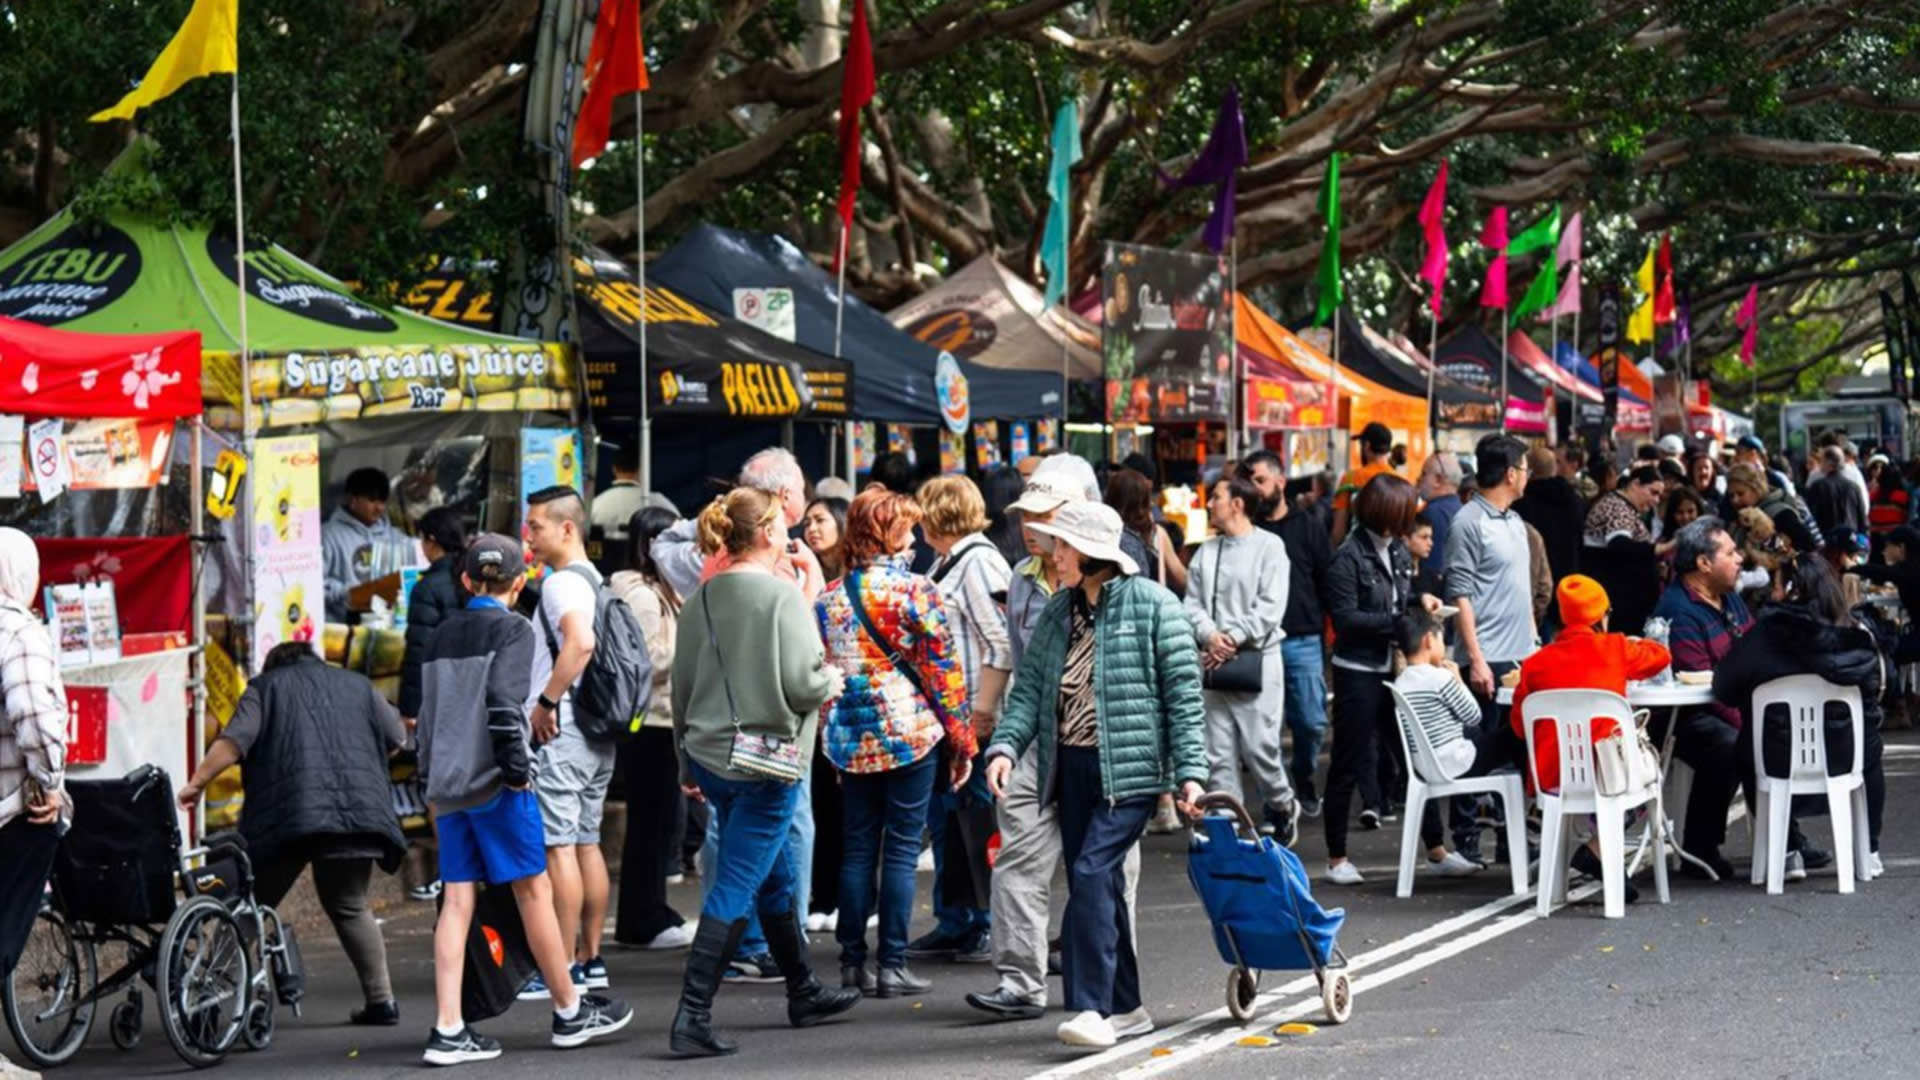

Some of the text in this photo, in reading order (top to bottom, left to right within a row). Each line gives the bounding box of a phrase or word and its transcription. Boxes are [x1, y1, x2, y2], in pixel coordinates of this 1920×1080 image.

[10, 248, 127, 285] TEBU
[286, 345, 545, 393] Sugarcane Juice
[721, 362, 800, 415] PAELLA
[410, 384, 446, 409] Bar
